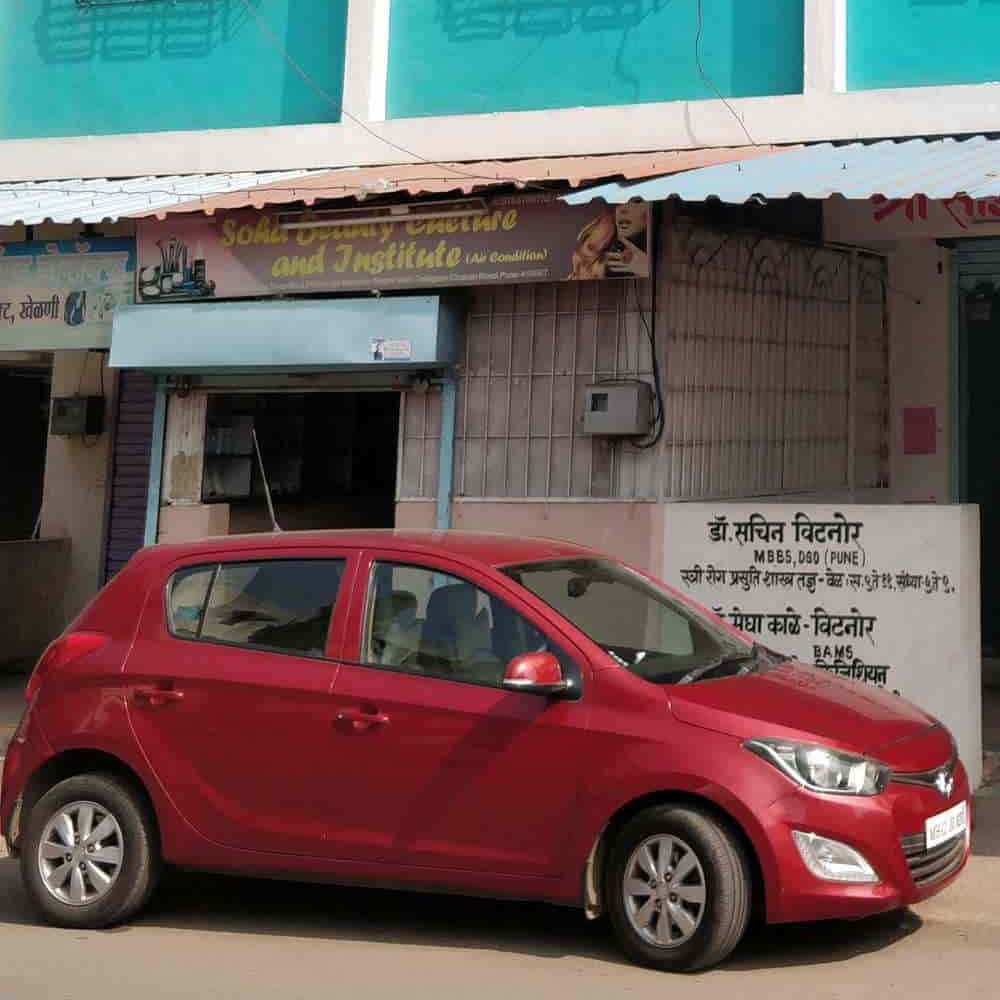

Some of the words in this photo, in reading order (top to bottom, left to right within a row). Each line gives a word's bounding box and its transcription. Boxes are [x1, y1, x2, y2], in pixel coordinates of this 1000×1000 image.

[271, 248, 325, 278] and
[332, 239, 463, 277] Institute
[791, 511, 864, 550] विटनोर
[824, 548, 866, 567] (PUNE)
[705, 564, 726, 585] रोग
[728, 565, 762, 592] प्रसुति
[813, 645, 853, 659] BAMS
